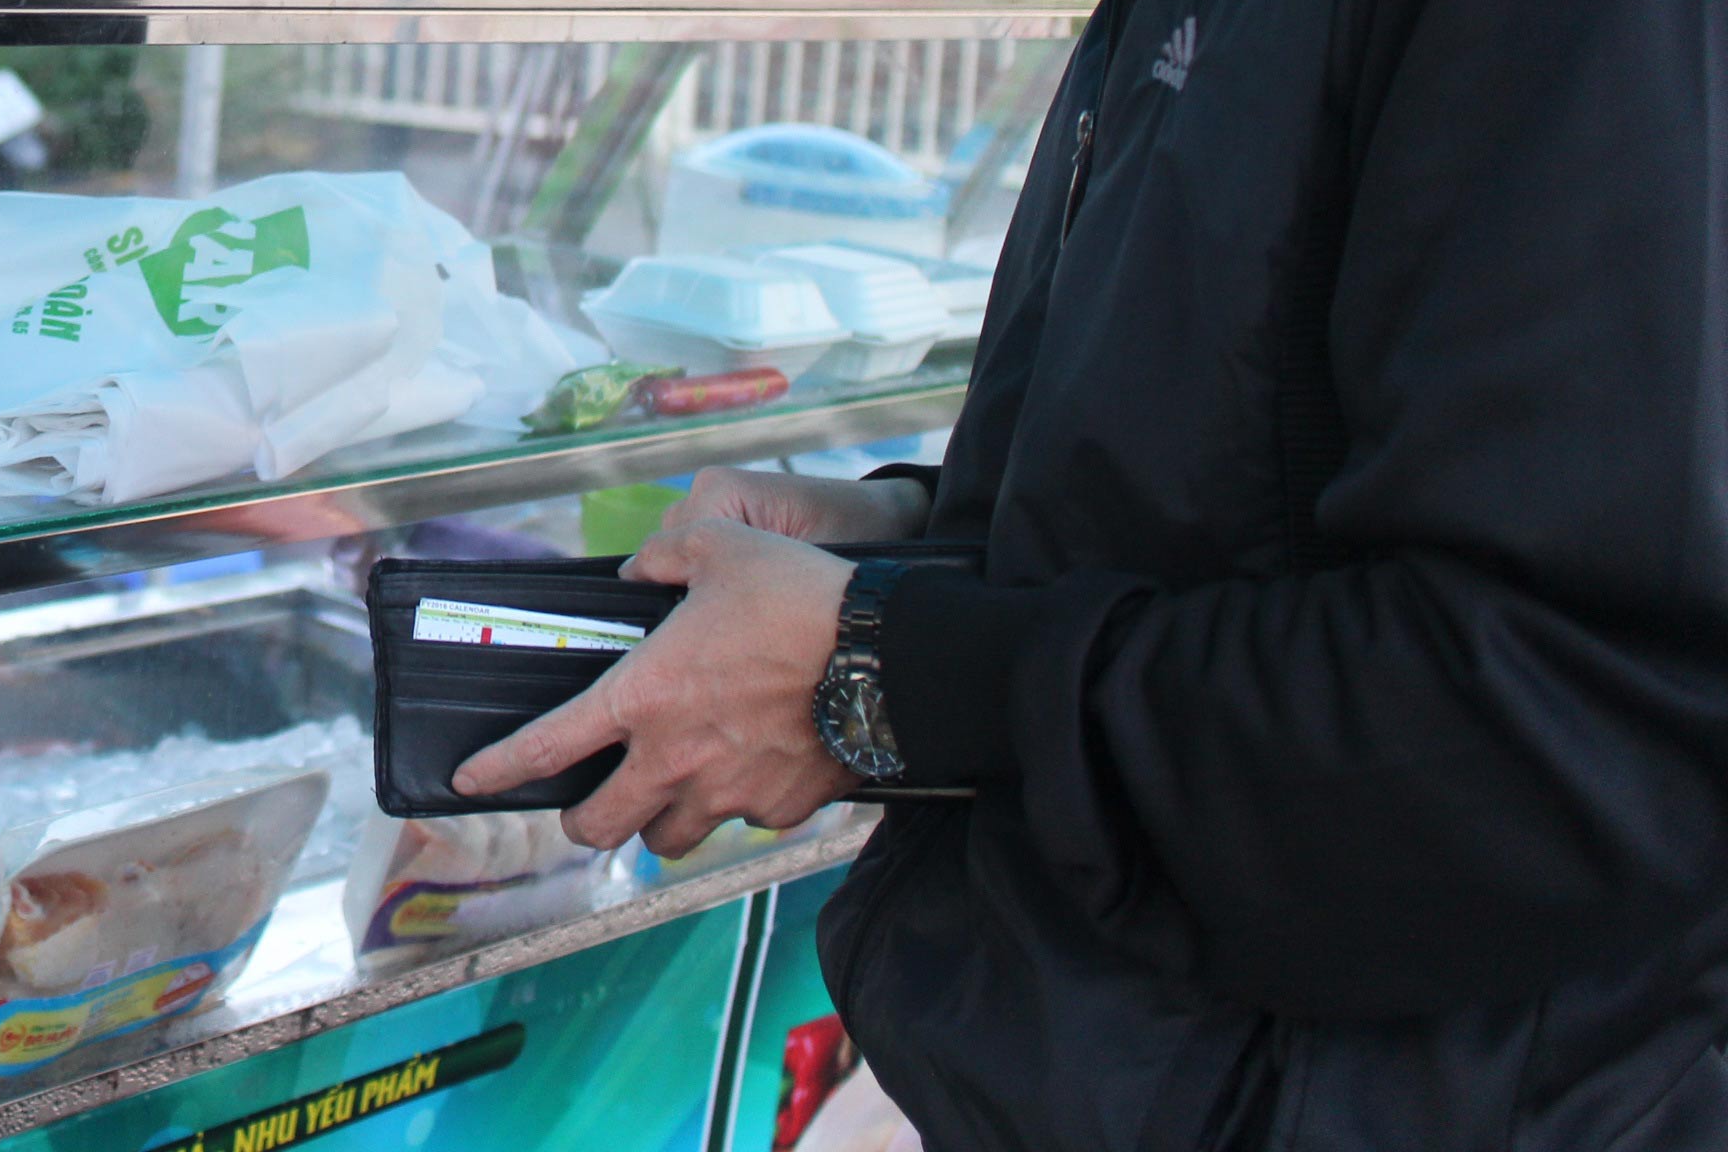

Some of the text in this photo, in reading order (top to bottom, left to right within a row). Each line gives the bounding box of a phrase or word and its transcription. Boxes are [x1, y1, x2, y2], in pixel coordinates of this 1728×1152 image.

[450, 603, 491, 615] CALENDAR
[306, 1081, 357, 1136] YẾU
[359, 1052, 441, 1115] PHẨM
